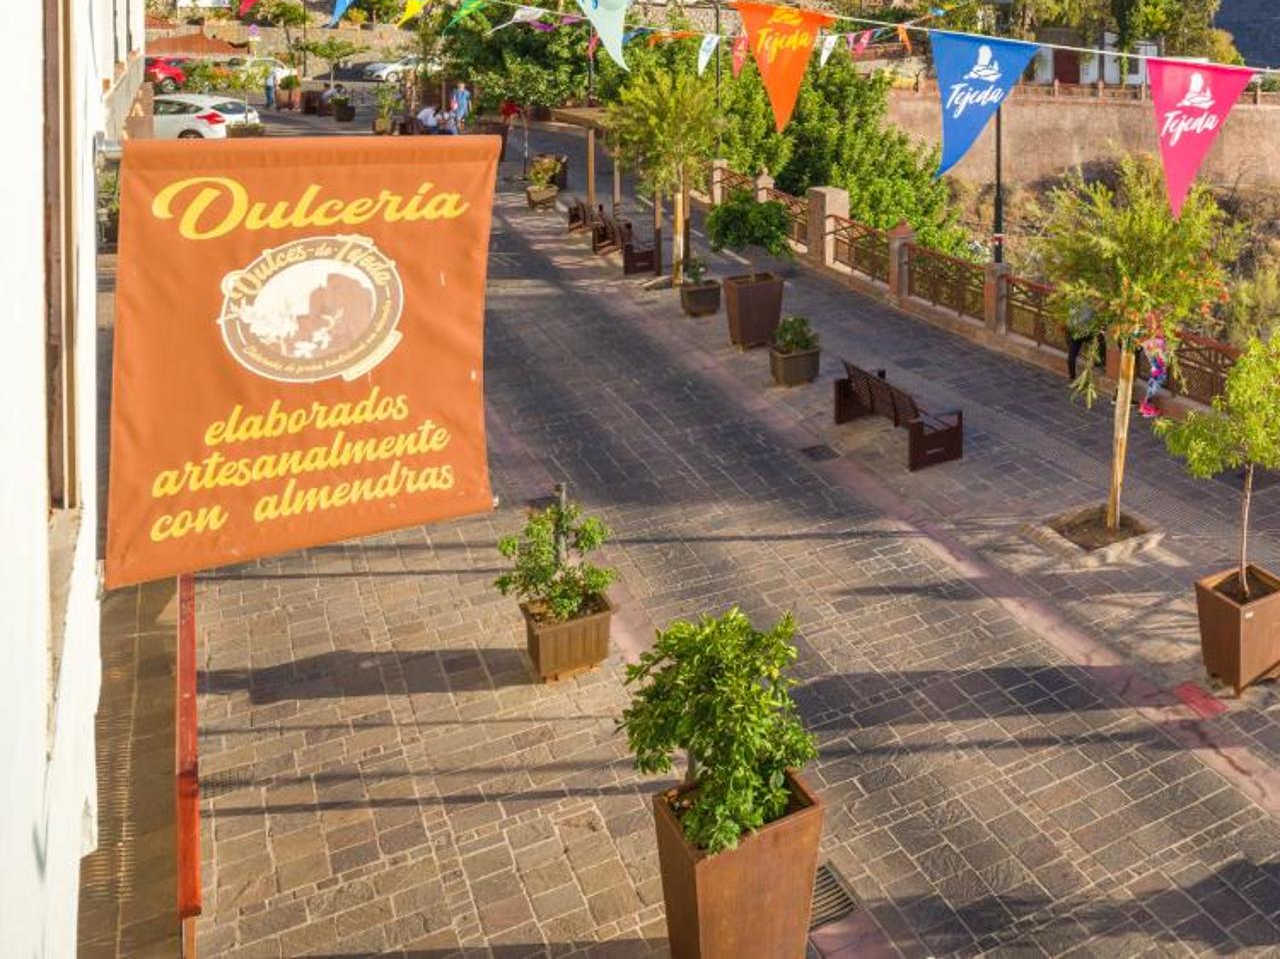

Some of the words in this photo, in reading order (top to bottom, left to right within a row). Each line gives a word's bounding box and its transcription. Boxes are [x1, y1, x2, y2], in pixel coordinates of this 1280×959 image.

[757, 28, 811, 64] Tejeda
[946, 83, 1004, 119] Tejeda
[1161, 110, 1220, 147] Tejeda
[151, 177, 470, 240] Dulcería
[204, 386, 409, 446] elaborados
[151, 420, 451, 498] artesanalmente
[151, 505, 229, 542] con
[253, 461, 456, 522] almendras
